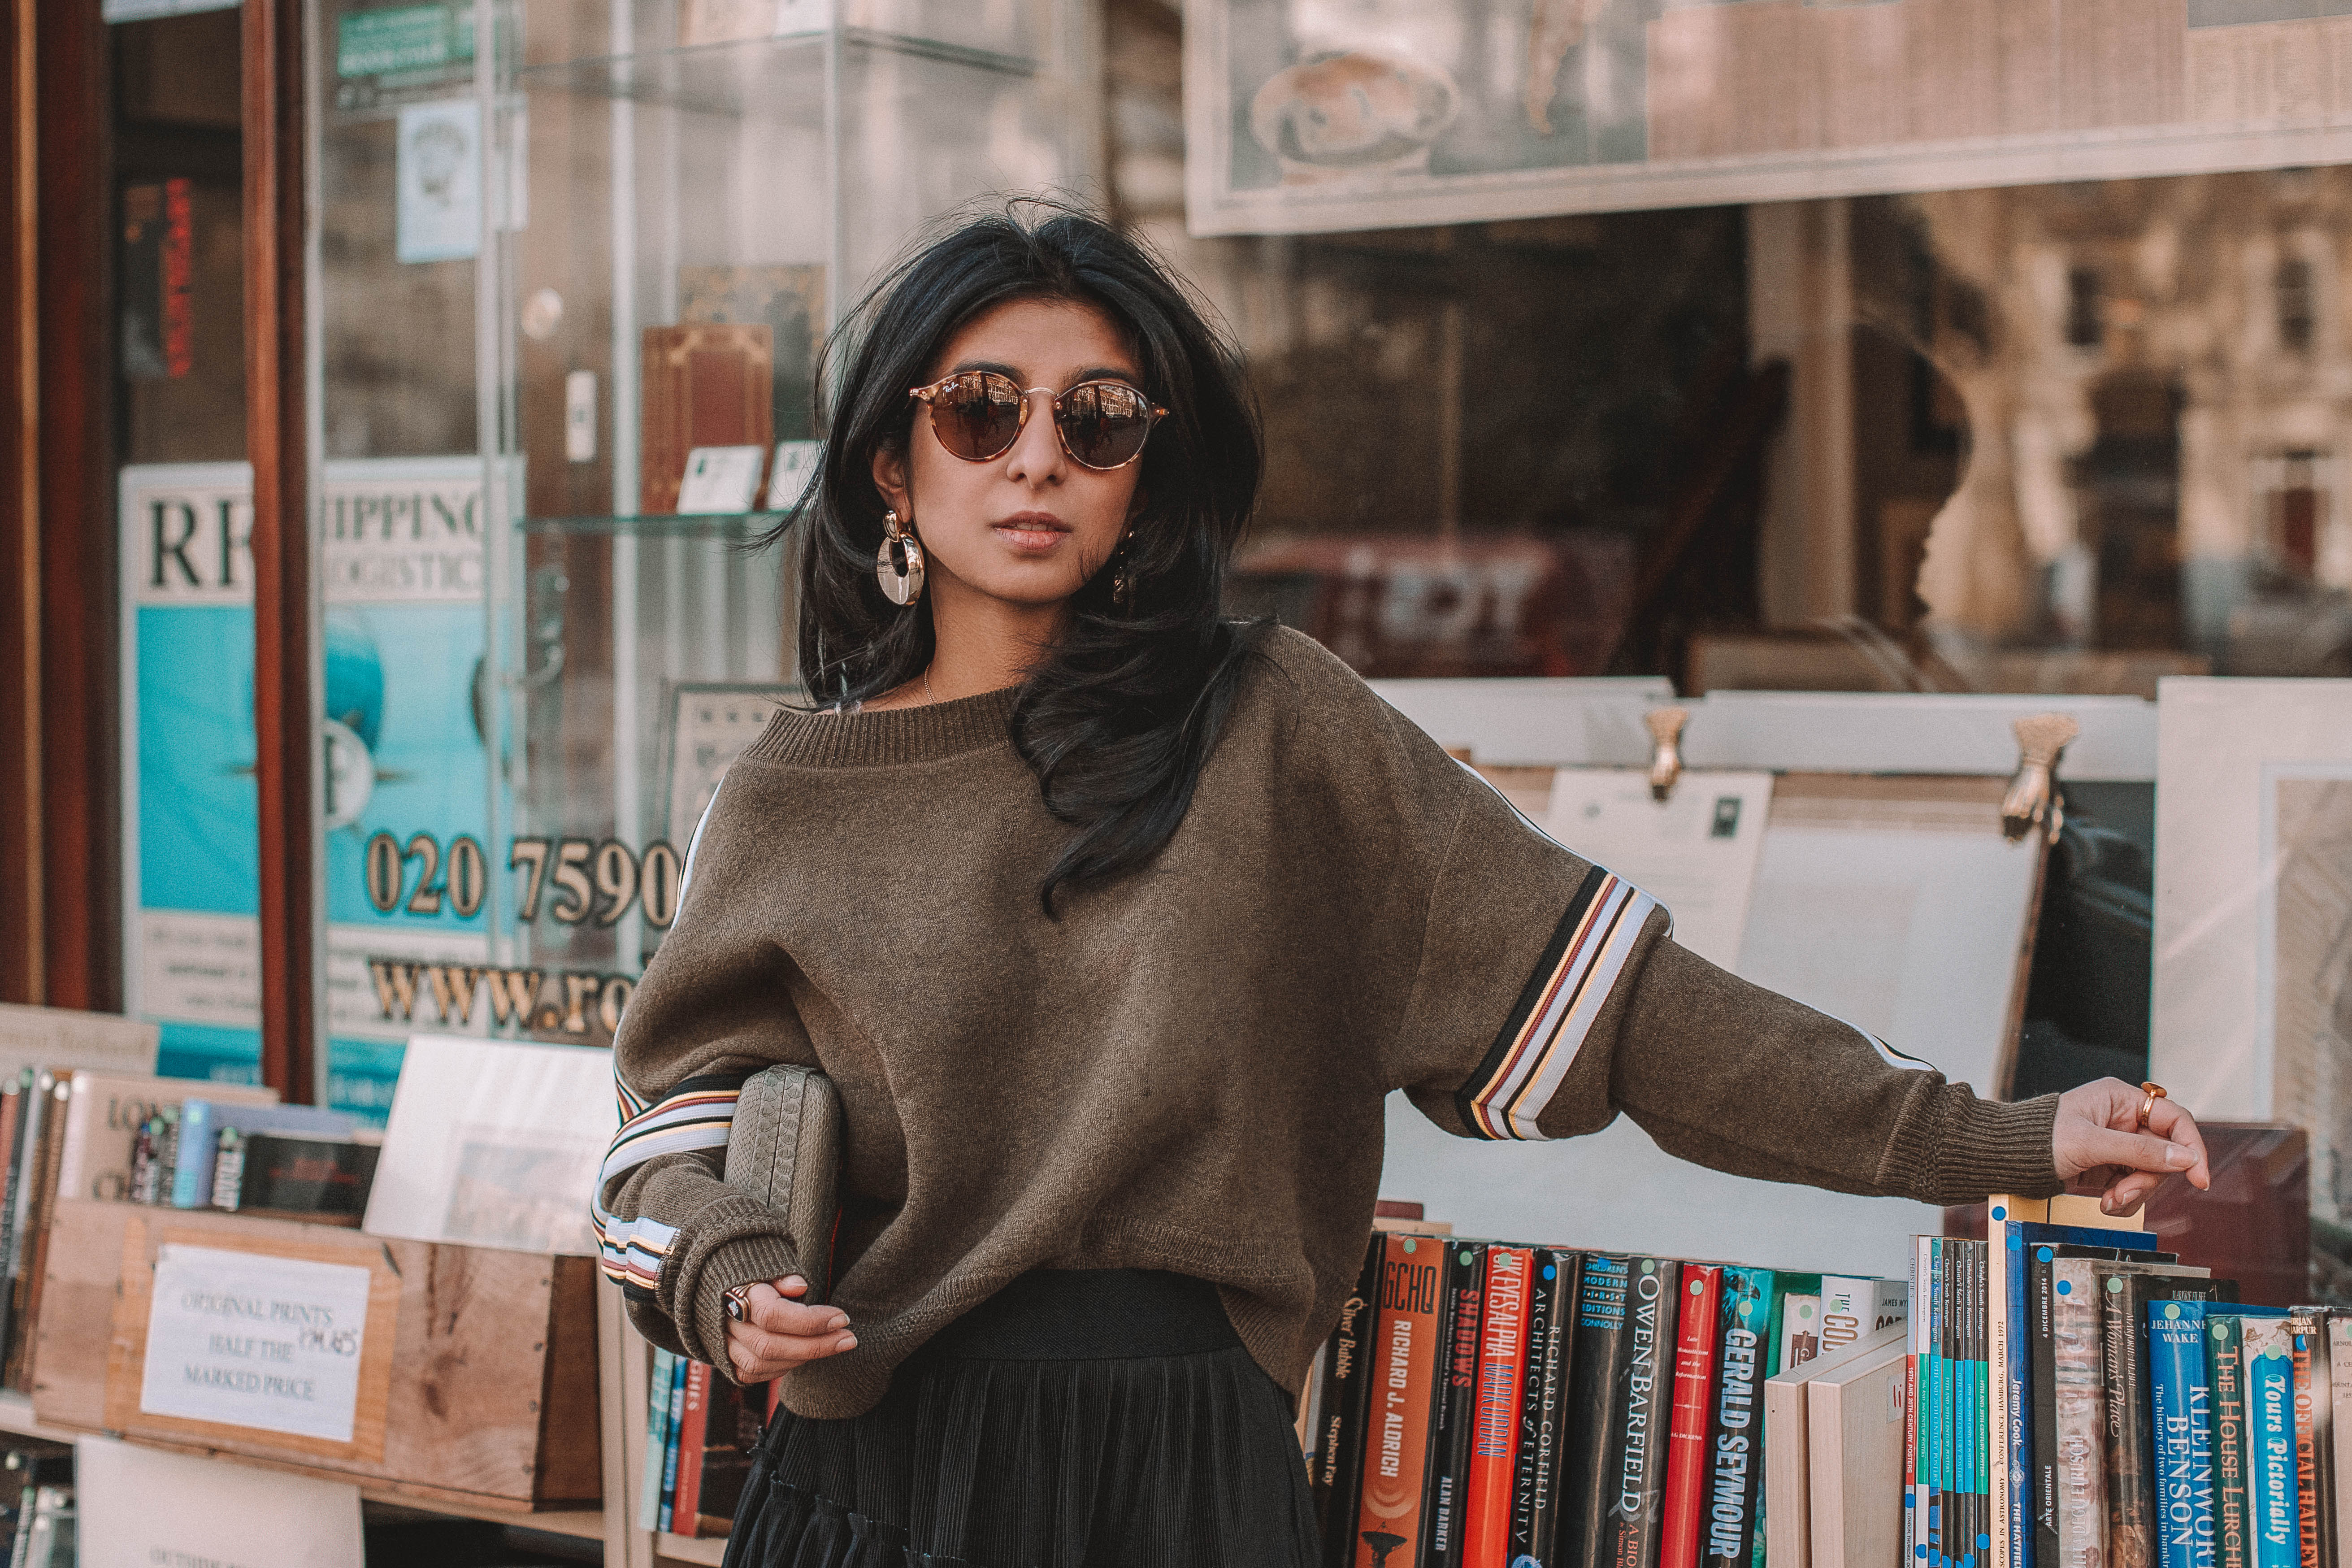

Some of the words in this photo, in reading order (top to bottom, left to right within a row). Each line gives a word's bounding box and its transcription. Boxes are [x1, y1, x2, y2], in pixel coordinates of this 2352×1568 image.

[367, 833, 485, 917] 020
[511, 836, 681, 928] 7590
[1492, 1255, 1523, 1276] UK
[1584, 1276, 1628, 1288] MODERN
[1383, 1260, 1437, 1315] GCHQ
[1489, 1275, 1522, 1311] EYES
[1882, 1298, 1898, 1307] JAMES
[2105, 1289, 2122, 1314] A
[180, 1292, 265, 1321] ORIGINAL
[269, 1301, 334, 1328] PRINTS
[1581, 1317, 1623, 1330] CONNOLLY
[1631, 1274, 1660, 1369] OWEN
[2291, 1325, 2317, 1335] ARPUR
[208, 1333, 255, 1359] HALF
[261, 1339, 294, 1364] THE
[1388, 1320, 1412, 1389] RICHARD
[1452, 1289, 1480, 1388] SHADOWS
[1484, 1310, 1519, 1357] ALPHA
[1526, 1288, 1546, 1411] ARCHITECTS
[1822, 1314, 1859, 1355] COD
[2107, 1319, 2124, 1381] Woman's
[2125, 1312, 2135, 1357] MARJORIE
[2162, 1333, 2198, 1343] WAKE
[1335, 1338, 1357, 1379] Bubble
[1542, 1325, 1561, 1411] RICHARD
[1719, 1327, 1757, 1429] GERALD
[2217, 1346, 2239, 1393] THE
[183, 1363, 263, 1394] MARKED
[263, 1372, 316, 1402] PRICE
[1386, 1391, 1406, 1408] J.
[1482, 1363, 1514, 1407] MARK
[2010, 1378, 2022, 1418] Jeremy
[2155, 1383, 2163, 1403] The
[2264, 1374, 2286, 1433] Yours
[1523, 1416, 1537, 1438] of
[2109, 1384, 2126, 1438] Place
[2155, 1406, 2165, 1441] history
[1326, 1415, 1342, 1464] Stephen
[1380, 1412, 1404, 1478] ALDRICH
[1478, 1407, 1510, 1458] URBAN
[1621, 1372, 1653, 1512] BARFIELD
[2012, 1419, 2023, 1446] Cook
[2158, 1444, 2166, 1456] of
[2219, 1400, 2241, 1479] HOUSE
[1534, 1420, 1553, 1510] CORFIELD
[2070, 1434, 2085, 1494] ETRUSCHI
[2166, 1414, 2194, 1547] BENSON
[2189, 1383, 2217, 1568] KLEINWOR
[1439, 1476, 1453, 1505] ALAN
[1515, 1441, 1535, 1543] ETERNITY
[1709, 1433, 1749, 1559] SEYMOUR
[2159, 1478, 2167, 1520] families
[2265, 1437, 2291, 1545] Pictorially
[1435, 1507, 1450, 1551] BARKER
[1629, 1524, 1639, 1535] A
[1999, 1527, 2005, 1536] IN
[2013, 1502, 2021, 1523] THE
[2071, 1499, 2086, 1534] DEGLI
[2161, 1522, 2167, 1532] in
[1617, 1529, 1626, 1555] Simon
[1626, 1540, 1639, 1568] BIO
[2013, 1525, 2022, 1568] HATFIEL
